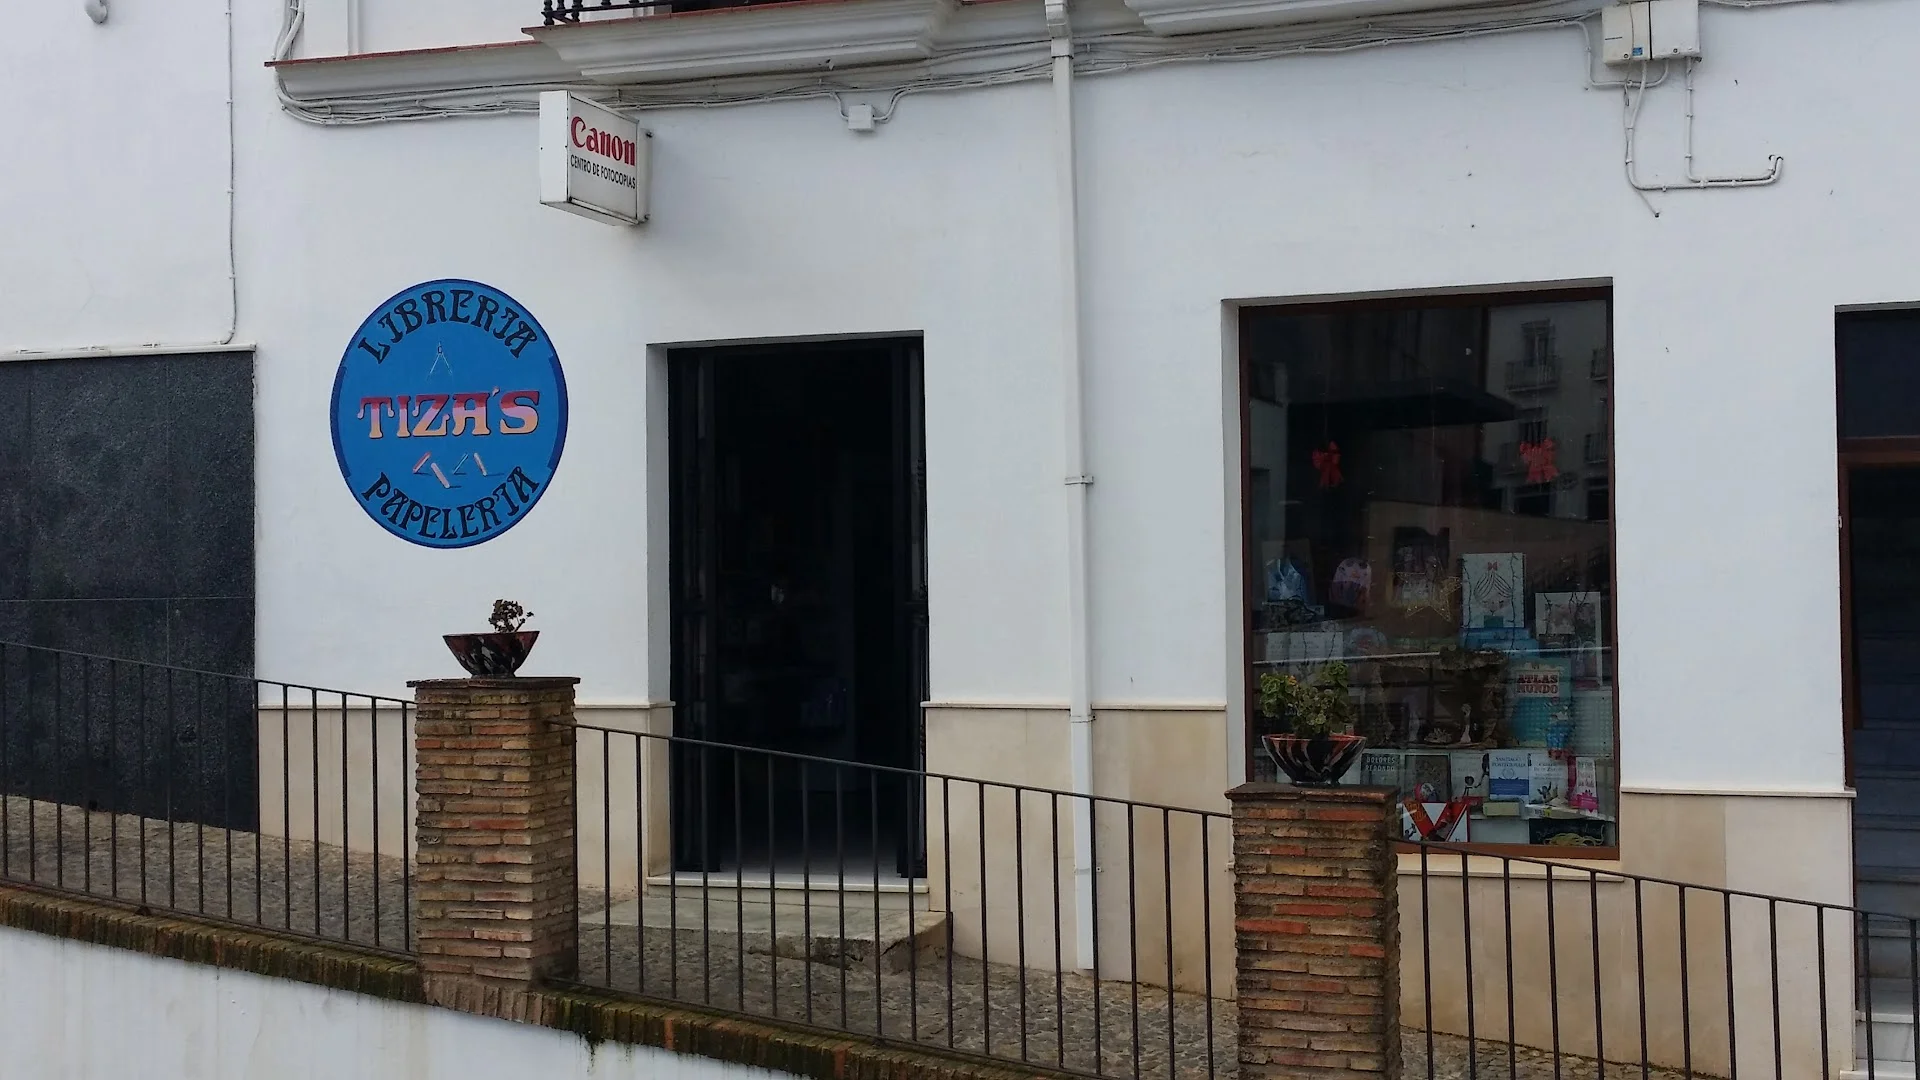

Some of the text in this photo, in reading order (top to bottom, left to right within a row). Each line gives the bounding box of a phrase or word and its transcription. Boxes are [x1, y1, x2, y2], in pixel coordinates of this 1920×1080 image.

[571, 116, 636, 167] Canon
[570, 154, 636, 189] CENTRO DE FOTOCOPIAS
[357, 289, 538, 364] LIBRERIA
[361, 466, 540, 540] PAPELERIA
[1517, 674, 1558, 684] ATLAS
[1366, 756, 1395, 764] DOLORES
